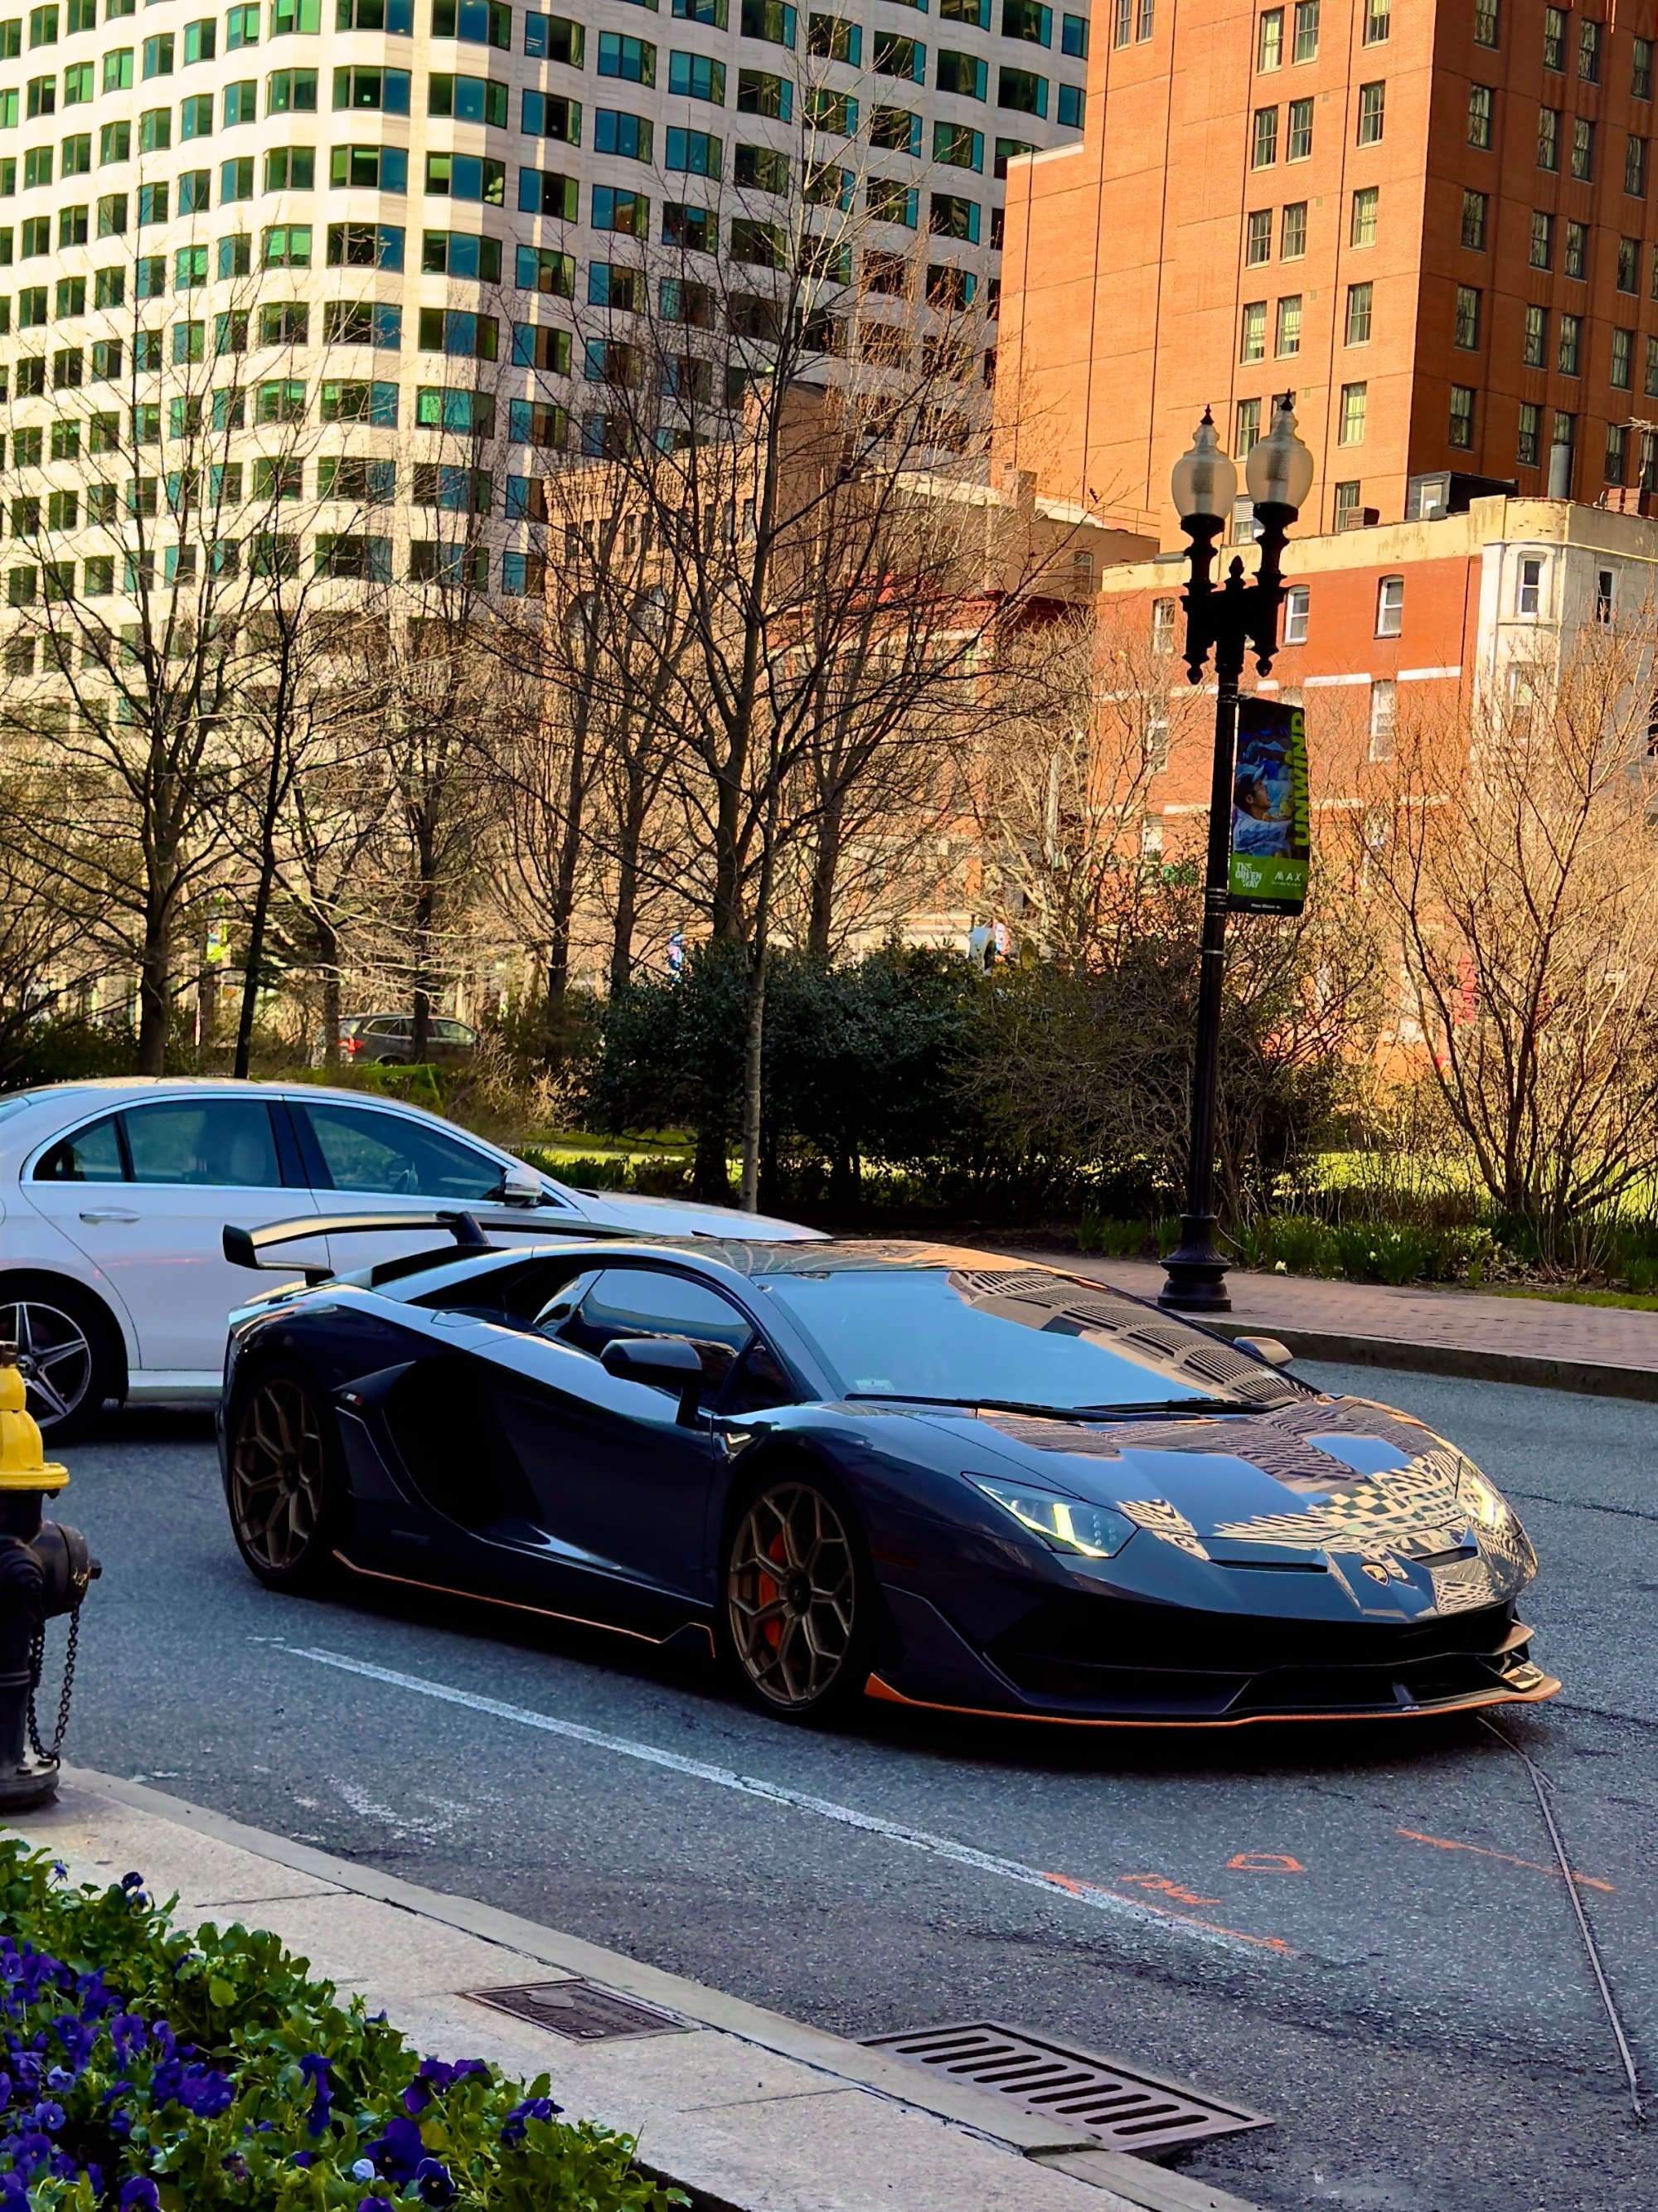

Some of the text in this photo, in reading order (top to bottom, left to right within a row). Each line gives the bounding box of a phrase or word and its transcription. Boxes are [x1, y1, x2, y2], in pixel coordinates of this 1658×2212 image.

[1291, 711, 1310, 846] UNWIND
[1234, 871, 1262, 880] GREEN
[1274, 871, 1302, 881] MAX
